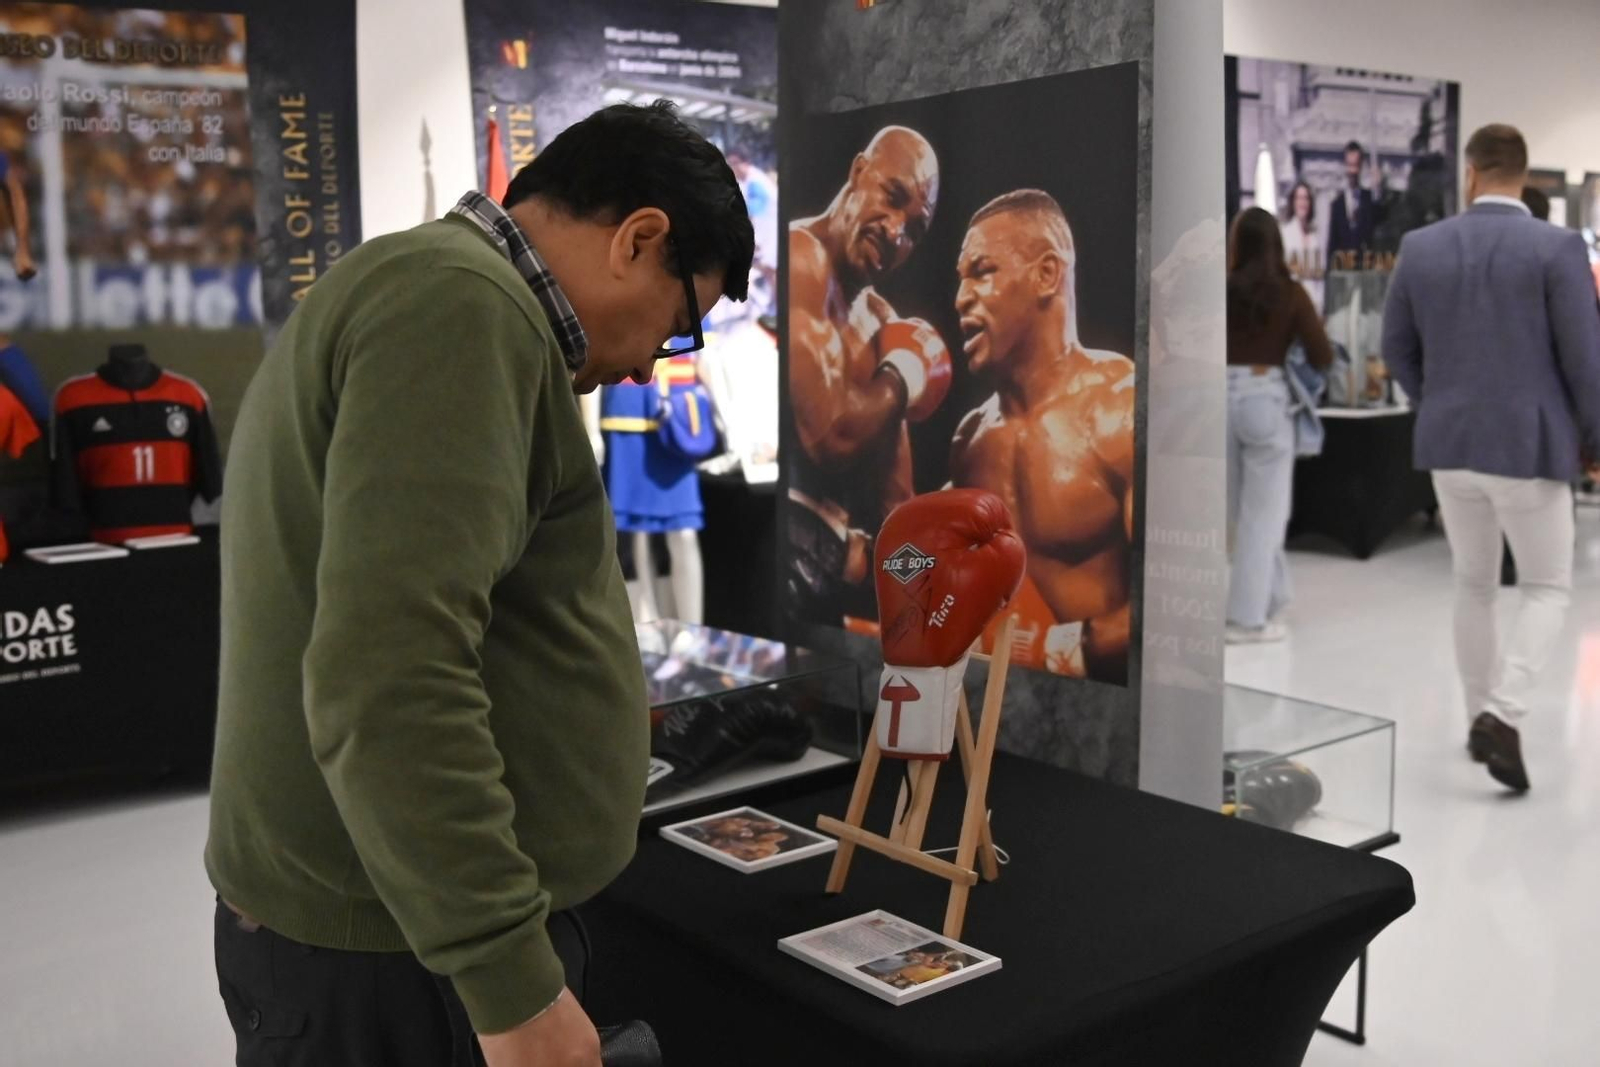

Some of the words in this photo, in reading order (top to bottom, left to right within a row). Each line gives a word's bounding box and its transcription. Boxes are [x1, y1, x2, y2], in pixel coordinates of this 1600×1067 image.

[0, 84, 55, 101] aolo
[63, 83, 135, 105] Rossi,
[142, 88, 222, 107] campeón
[62, 115, 122, 132] mundo
[127, 114, 194, 137] España
[279, 91, 311, 180] FAME
[149, 147, 179, 162] con
[184, 144, 225, 162] Italia
[285, 194, 313, 238] OF
[132, 445, 155, 482] 11
[882, 558, 904, 571] RUDE
[908, 556, 936, 569] BOYS
[0, 603, 76, 639] DAS
